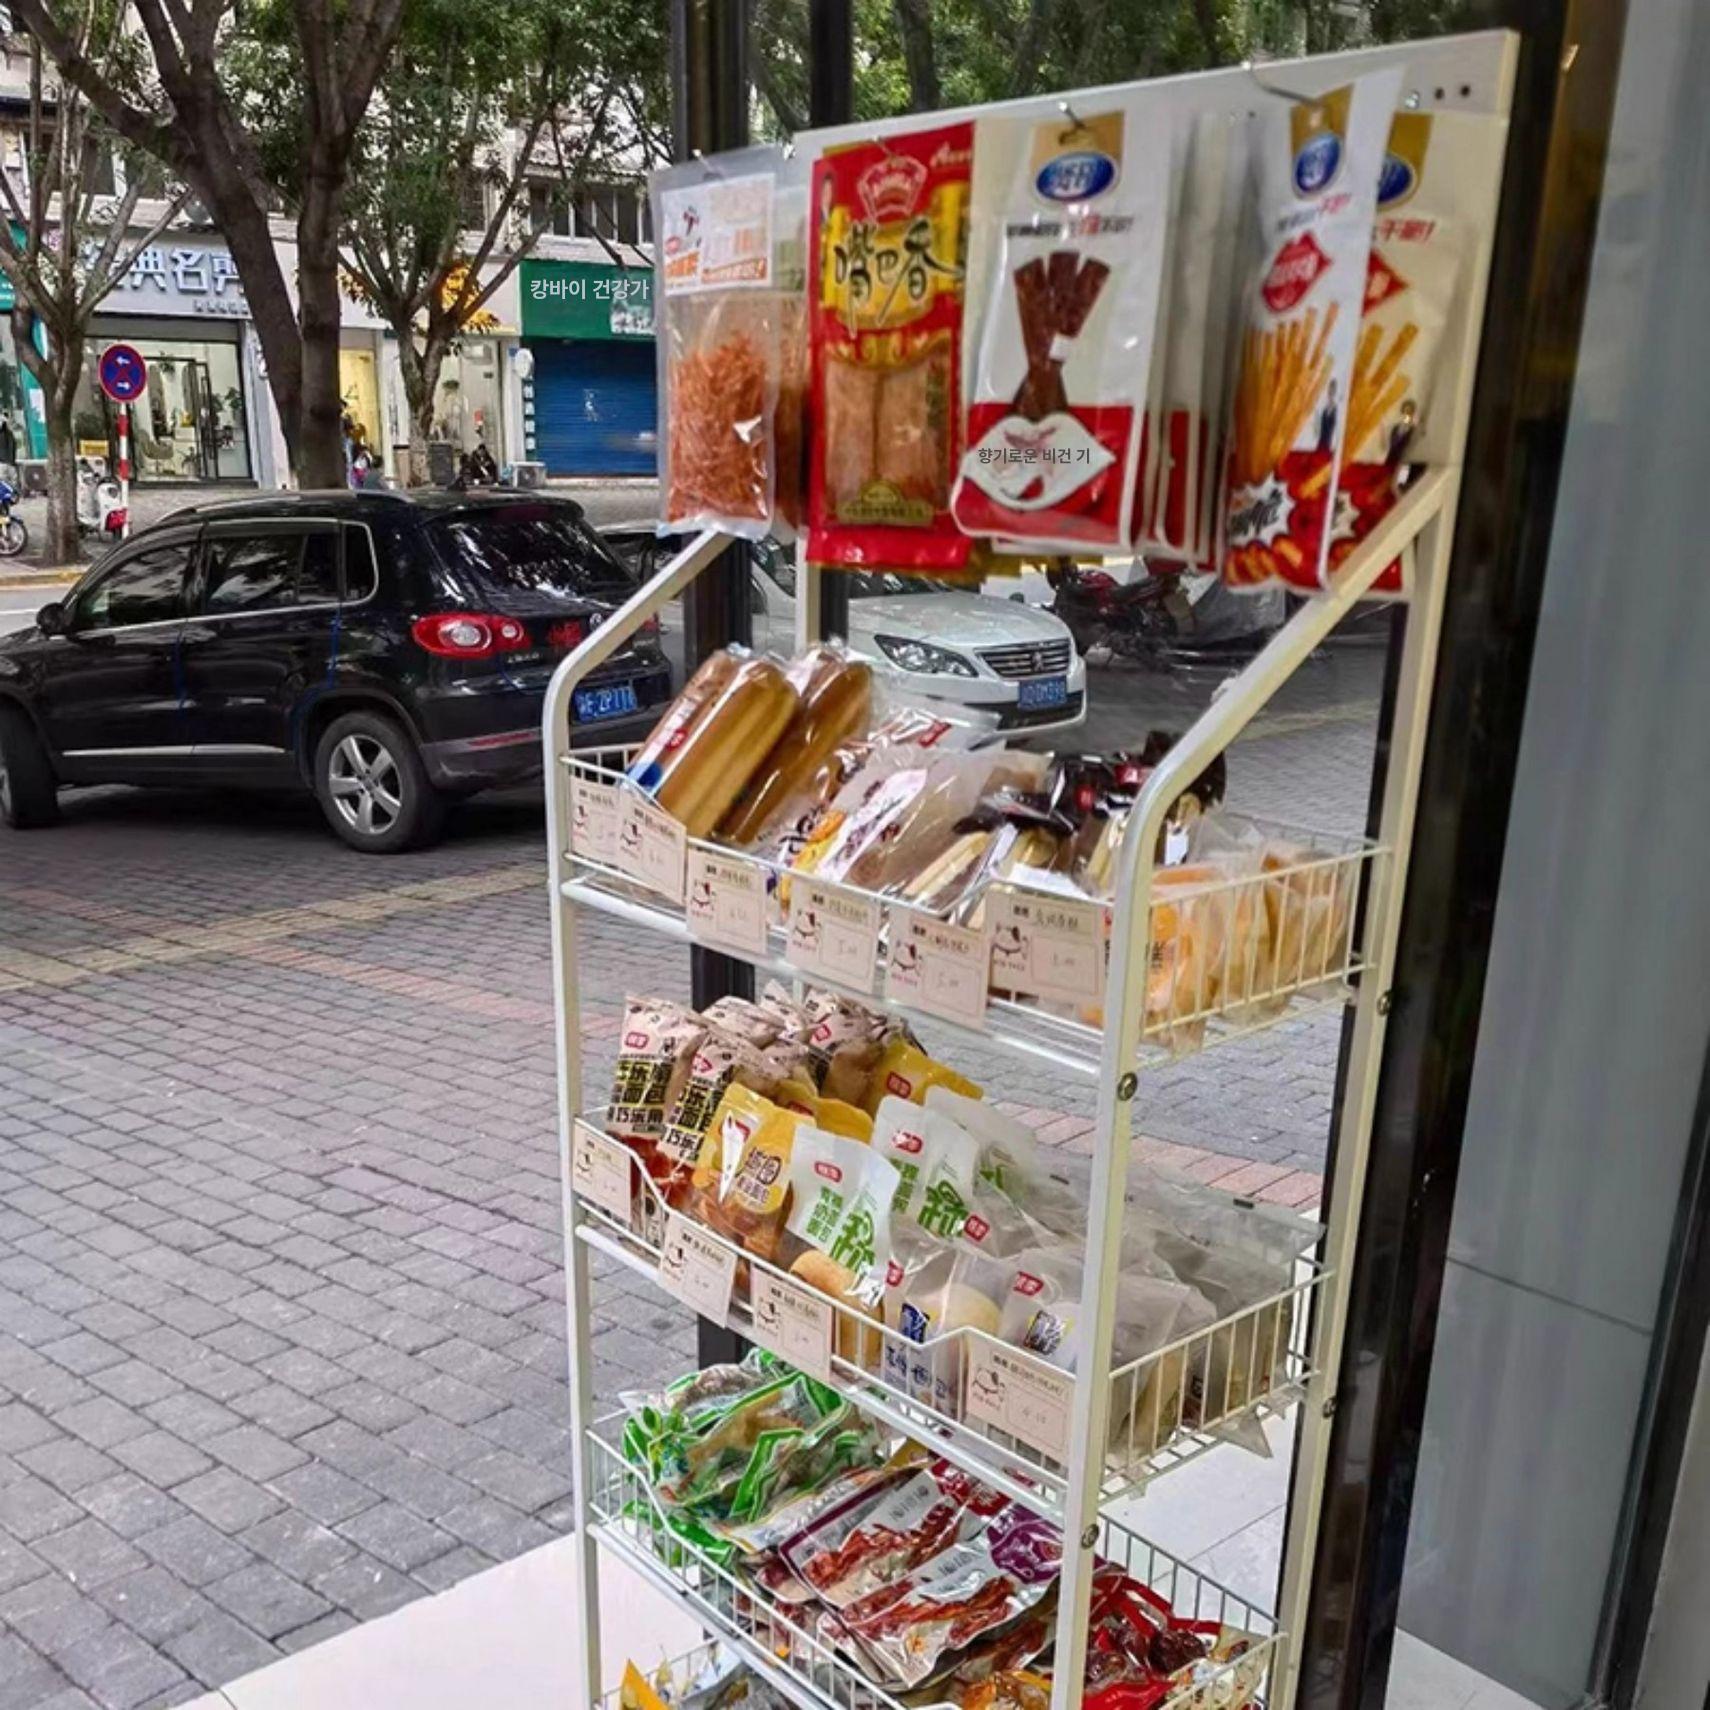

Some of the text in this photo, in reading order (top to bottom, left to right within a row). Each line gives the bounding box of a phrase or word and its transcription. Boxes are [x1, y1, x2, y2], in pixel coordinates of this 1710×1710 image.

[530, 278, 650, 300] 캉바이 건강가
[978, 448, 1090, 464] 향기로운 비건 기
